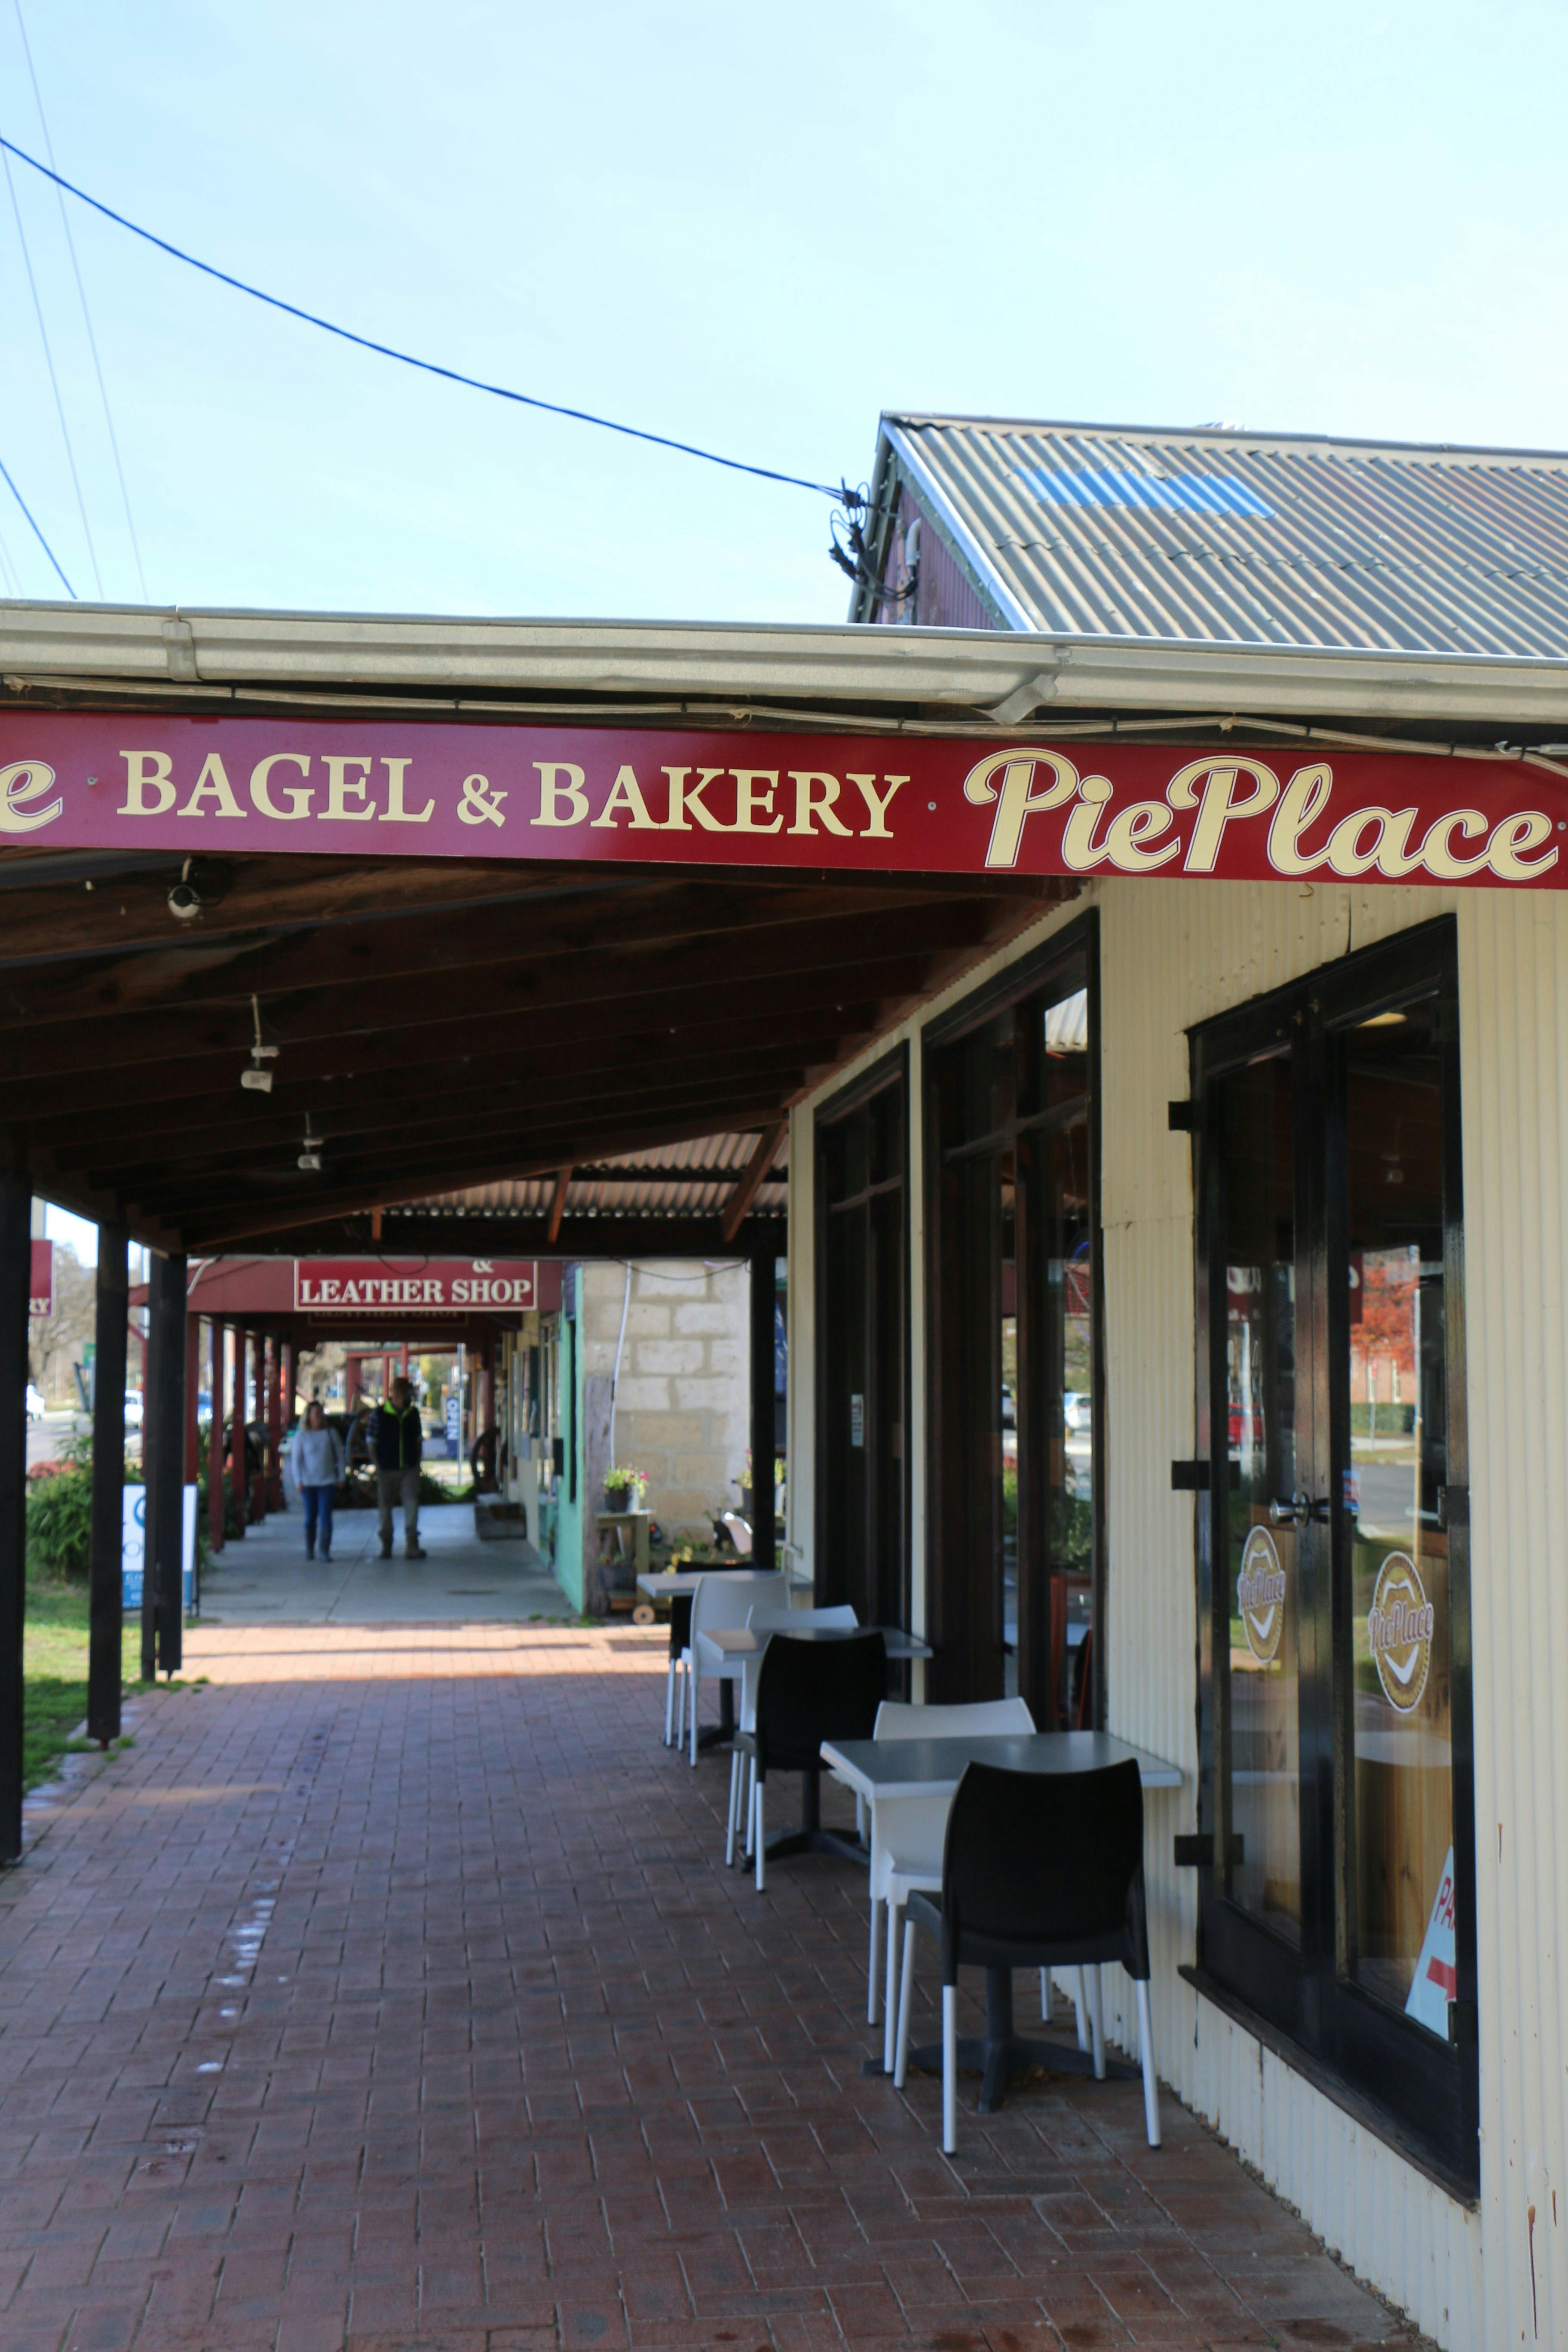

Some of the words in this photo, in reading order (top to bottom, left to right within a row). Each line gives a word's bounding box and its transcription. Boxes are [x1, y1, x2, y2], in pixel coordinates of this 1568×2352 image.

[116, 750, 435, 822] BAGEL
[456, 773, 508, 828] &
[530, 761, 910, 838] BAKERY
[300, 1279, 445, 1304] LEATHER
[451, 1279, 532, 1304] SHOP
[1434, 1877, 1455, 1930] PA
